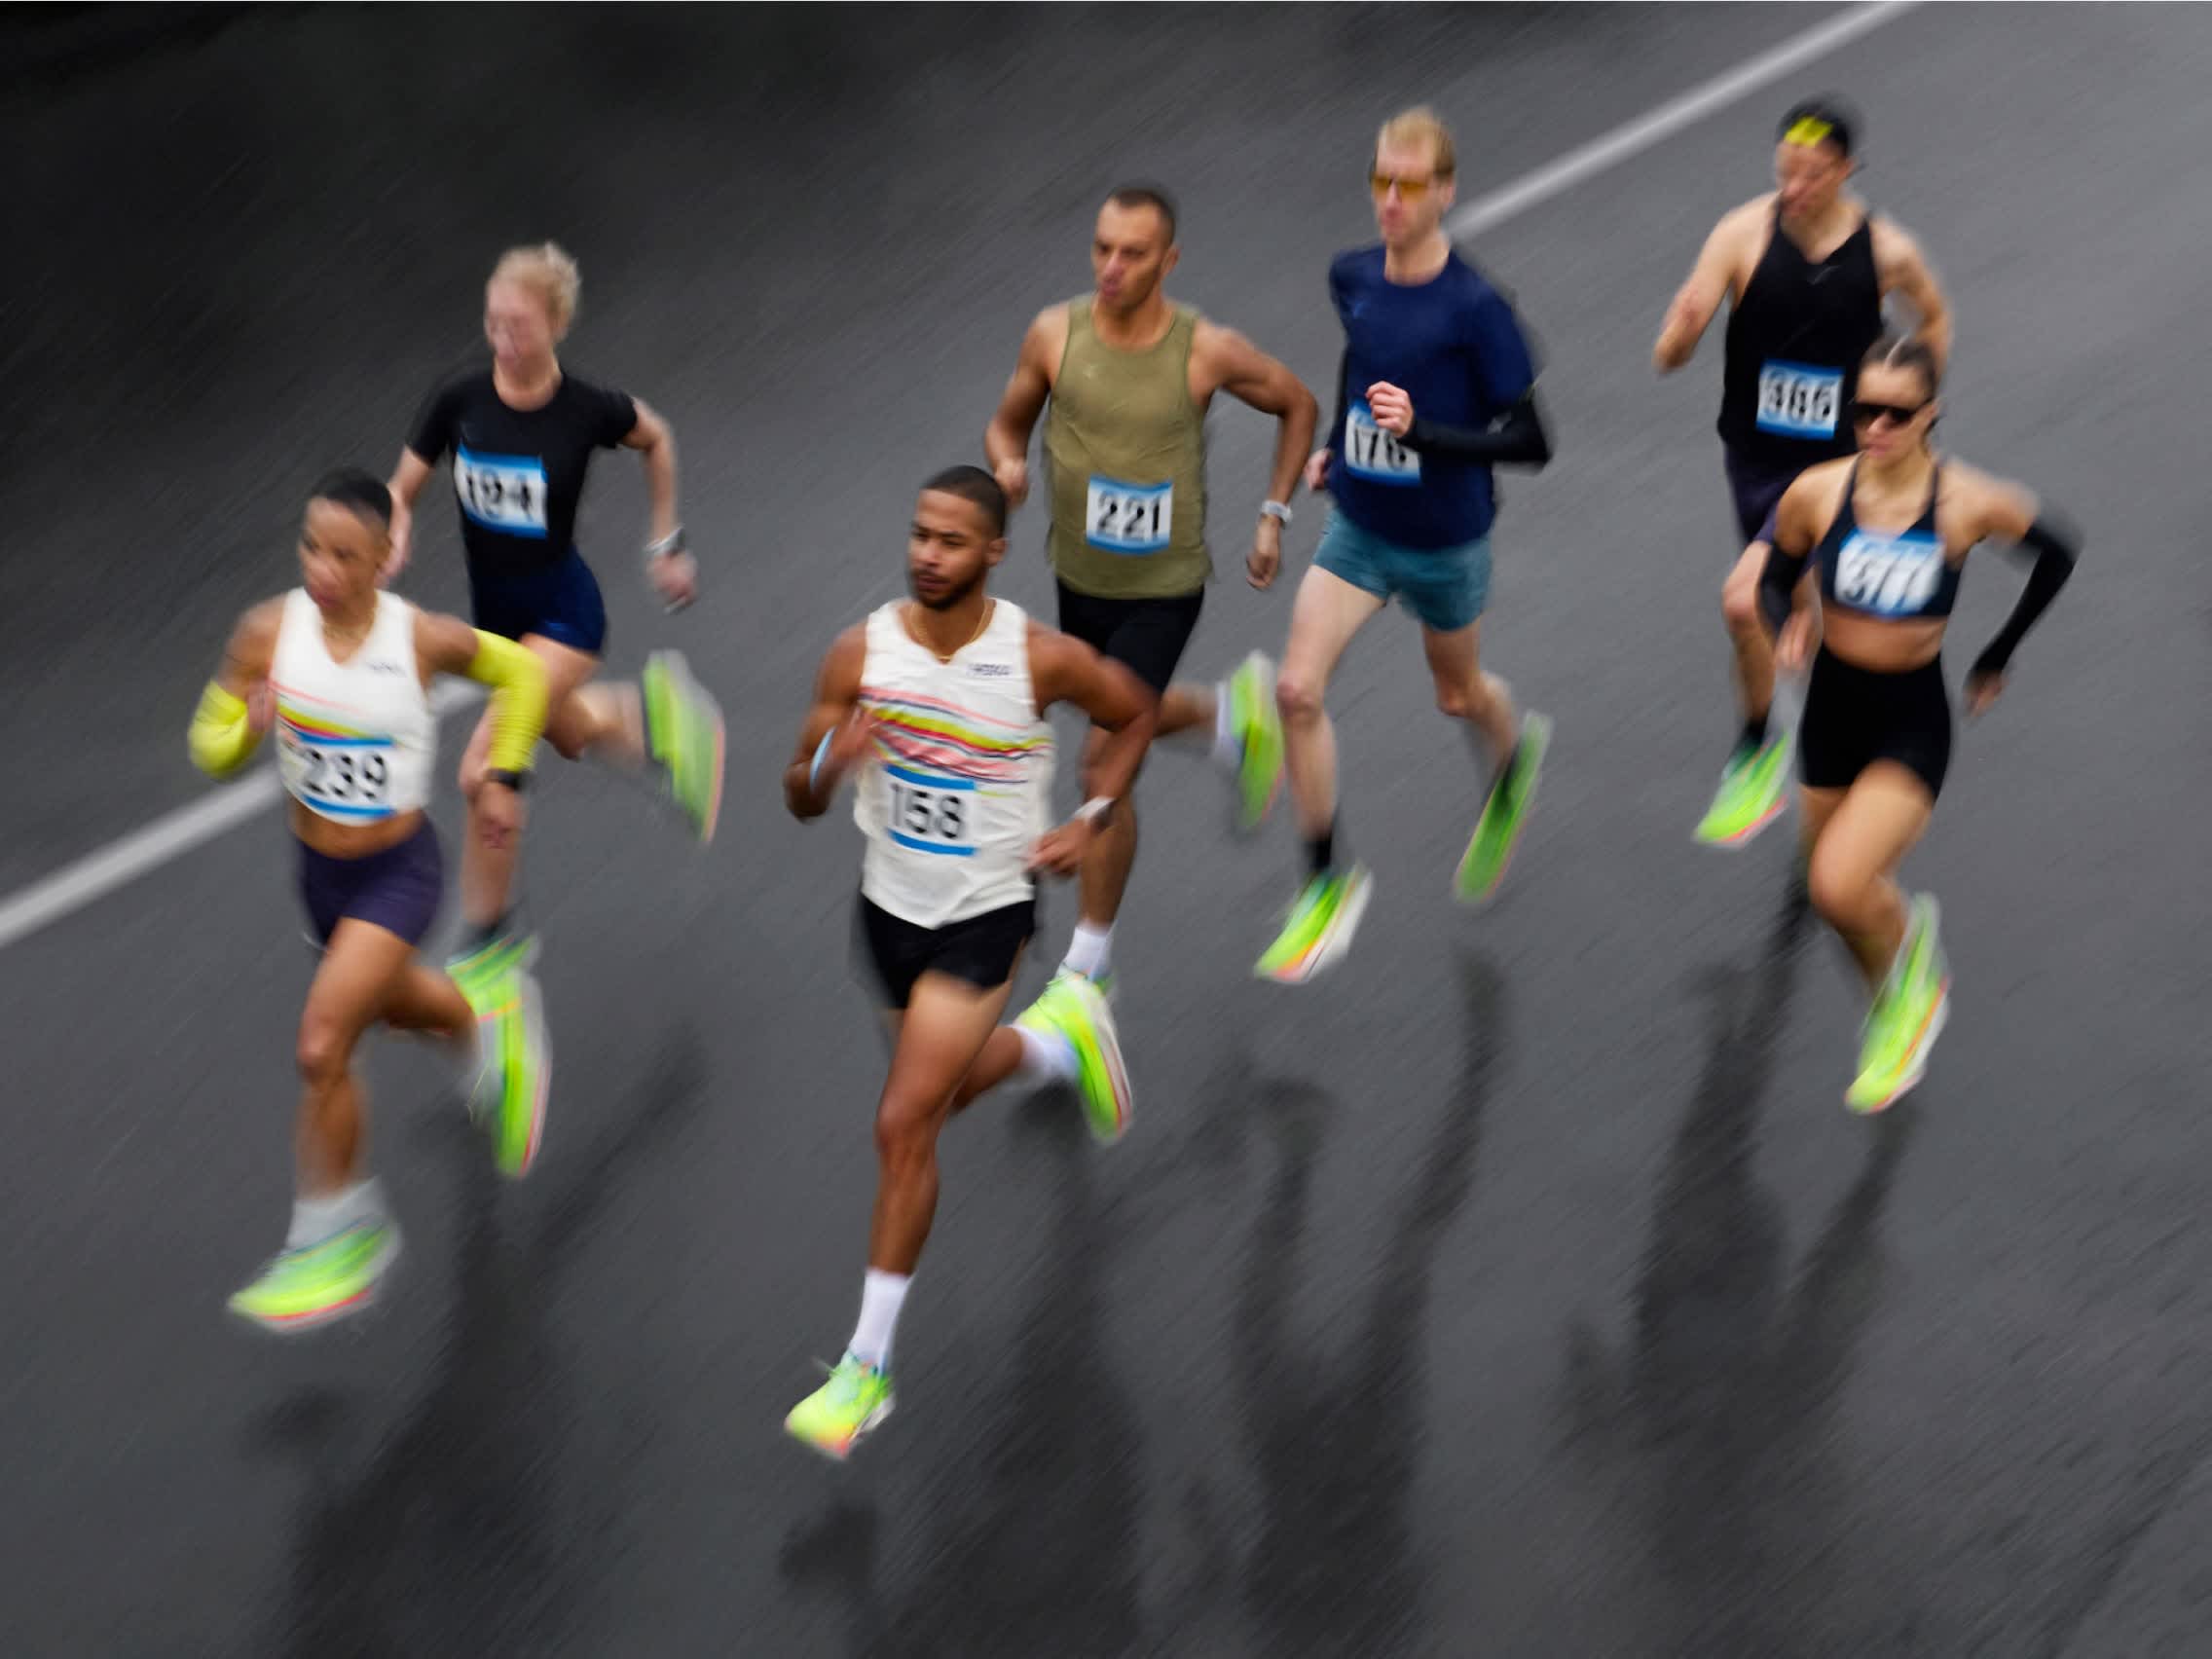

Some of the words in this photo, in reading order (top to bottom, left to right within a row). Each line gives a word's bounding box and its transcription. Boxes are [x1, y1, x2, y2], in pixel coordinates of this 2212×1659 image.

[1096, 489, 1161, 542] 221
[299, 747, 387, 800] 239
[890, 783, 966, 840] 158
